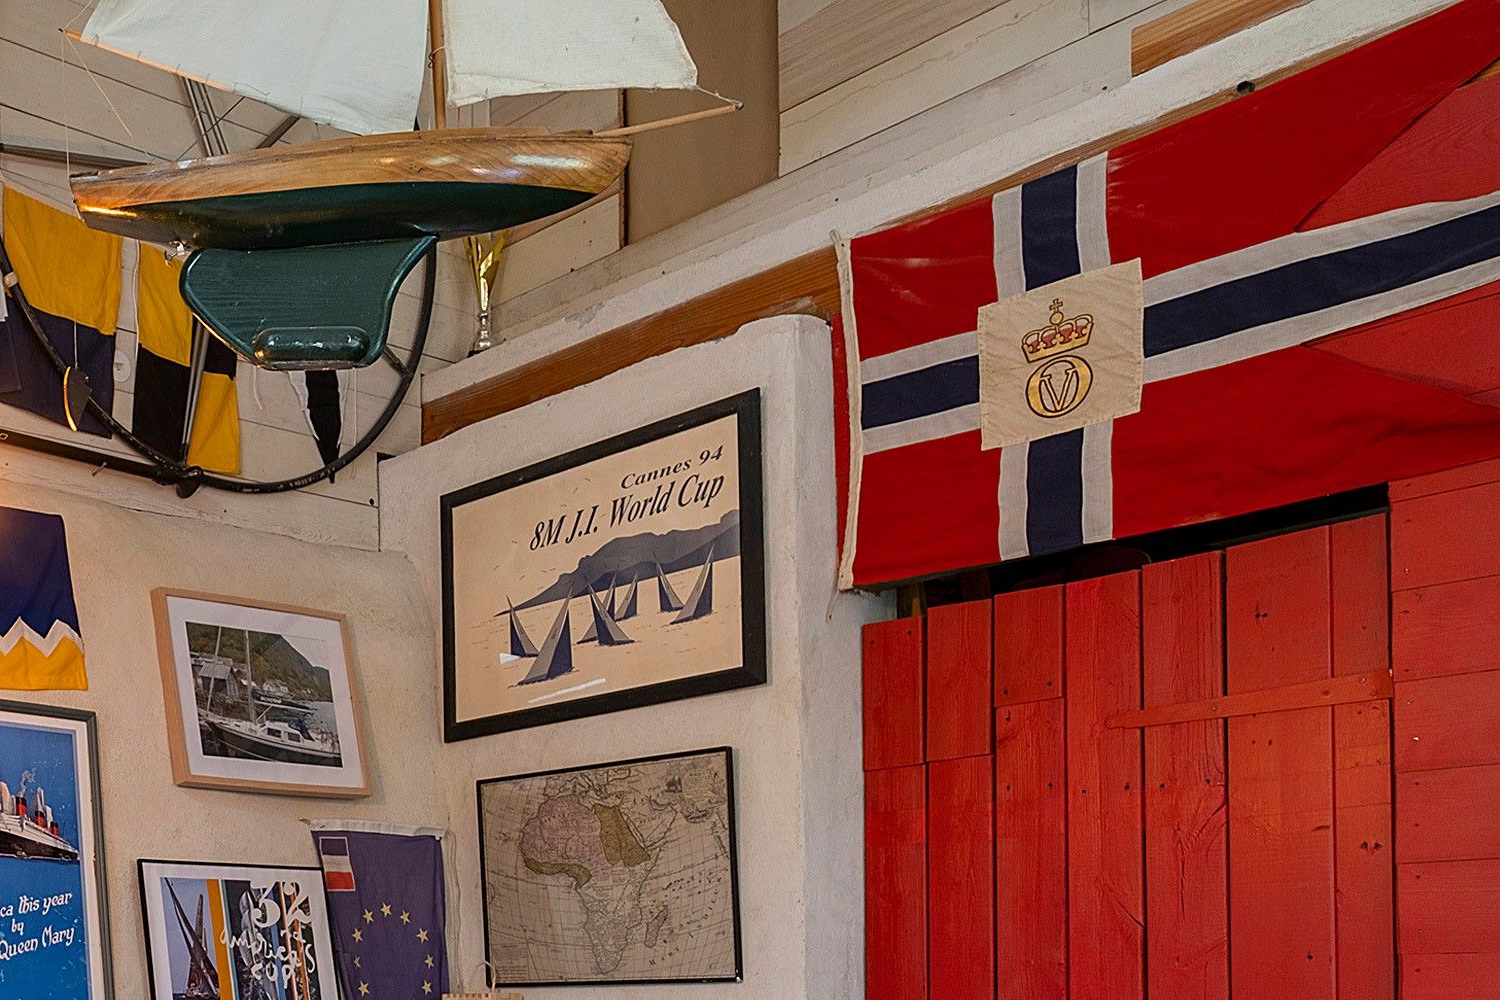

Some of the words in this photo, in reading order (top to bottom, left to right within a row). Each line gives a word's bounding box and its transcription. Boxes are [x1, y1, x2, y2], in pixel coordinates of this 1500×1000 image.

[621, 459, 692, 489] Cannes
[699, 445, 724, 466] 94
[530, 515, 567, 551] 8M
[610, 481, 676, 528] World
[678, 473, 725, 509] Cup
[19, 895, 40, 914] this
[42, 892, 72, 916] year
[11, 918, 24, 936] by
